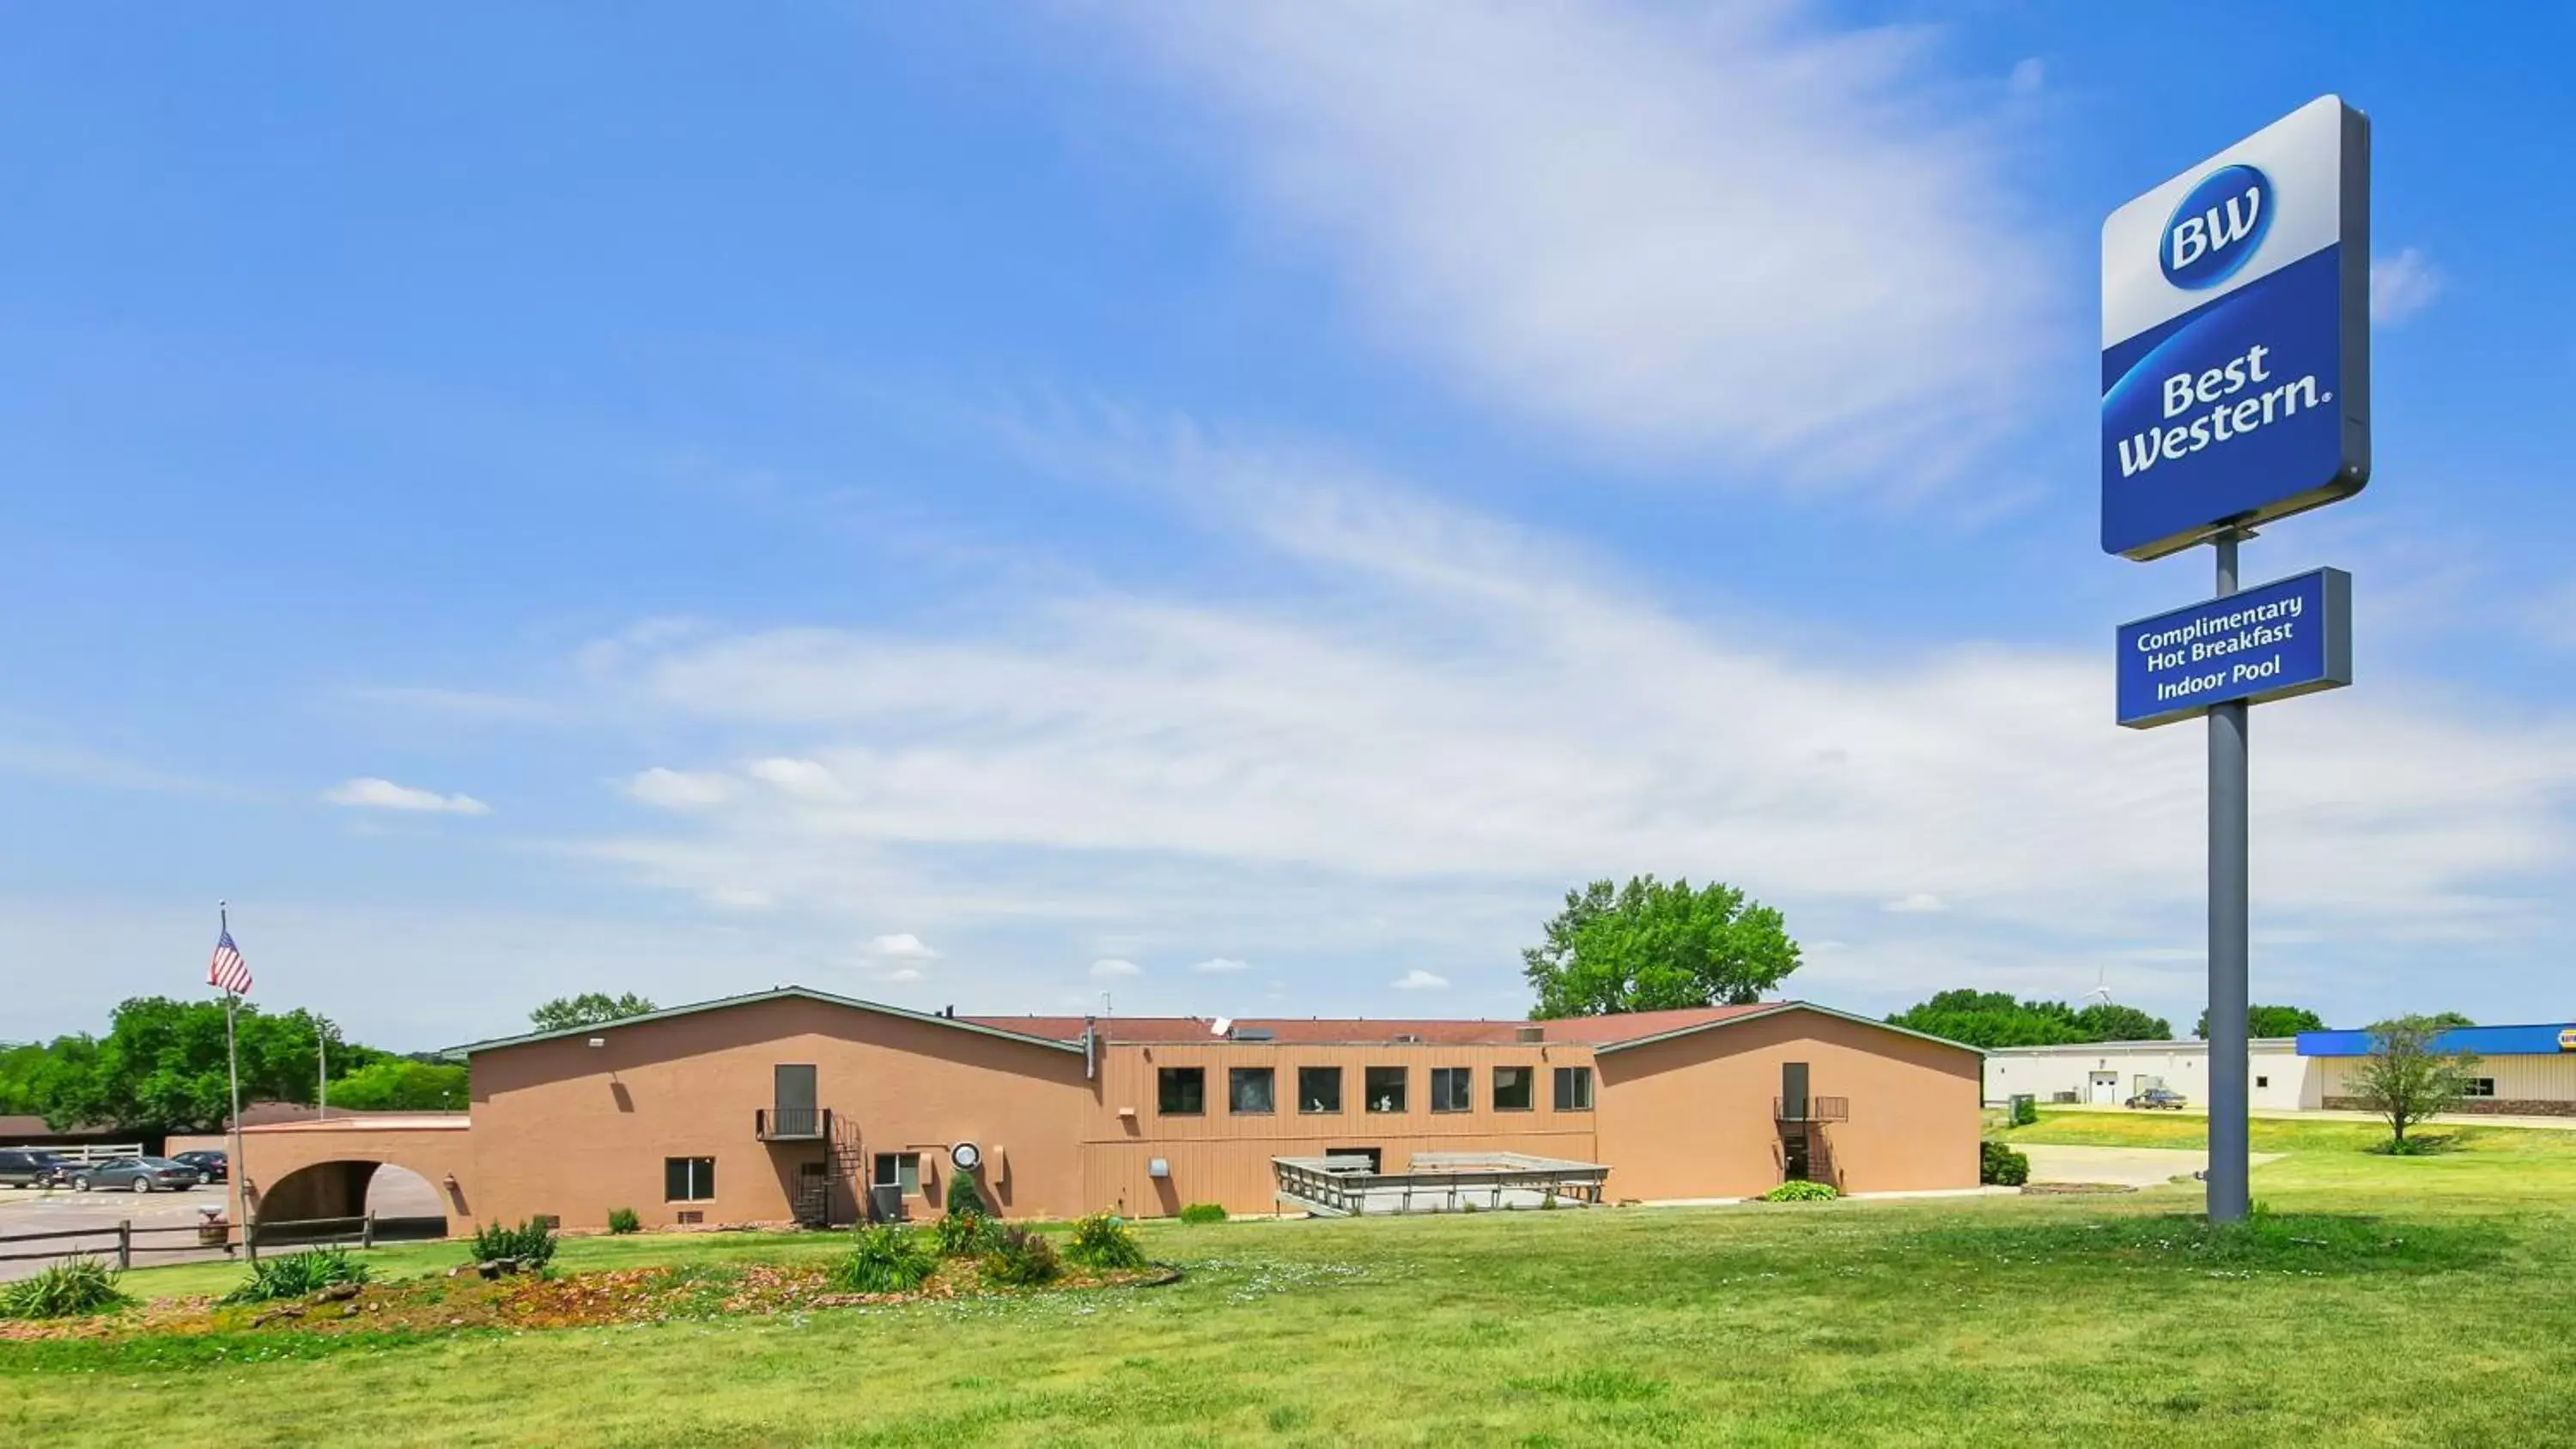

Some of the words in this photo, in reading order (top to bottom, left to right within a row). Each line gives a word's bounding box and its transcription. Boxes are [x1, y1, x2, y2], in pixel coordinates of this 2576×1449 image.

[2172, 186, 2260, 270] BW
[2162, 344, 2270, 420] Best
[2137, 597, 2302, 652] Complimentary
[2148, 651, 2185, 672] Hot
[2192, 621, 2293, 662] Breakfast
[2158, 671, 2226, 700] Indoor
[2233, 654, 2280, 683] Pool
